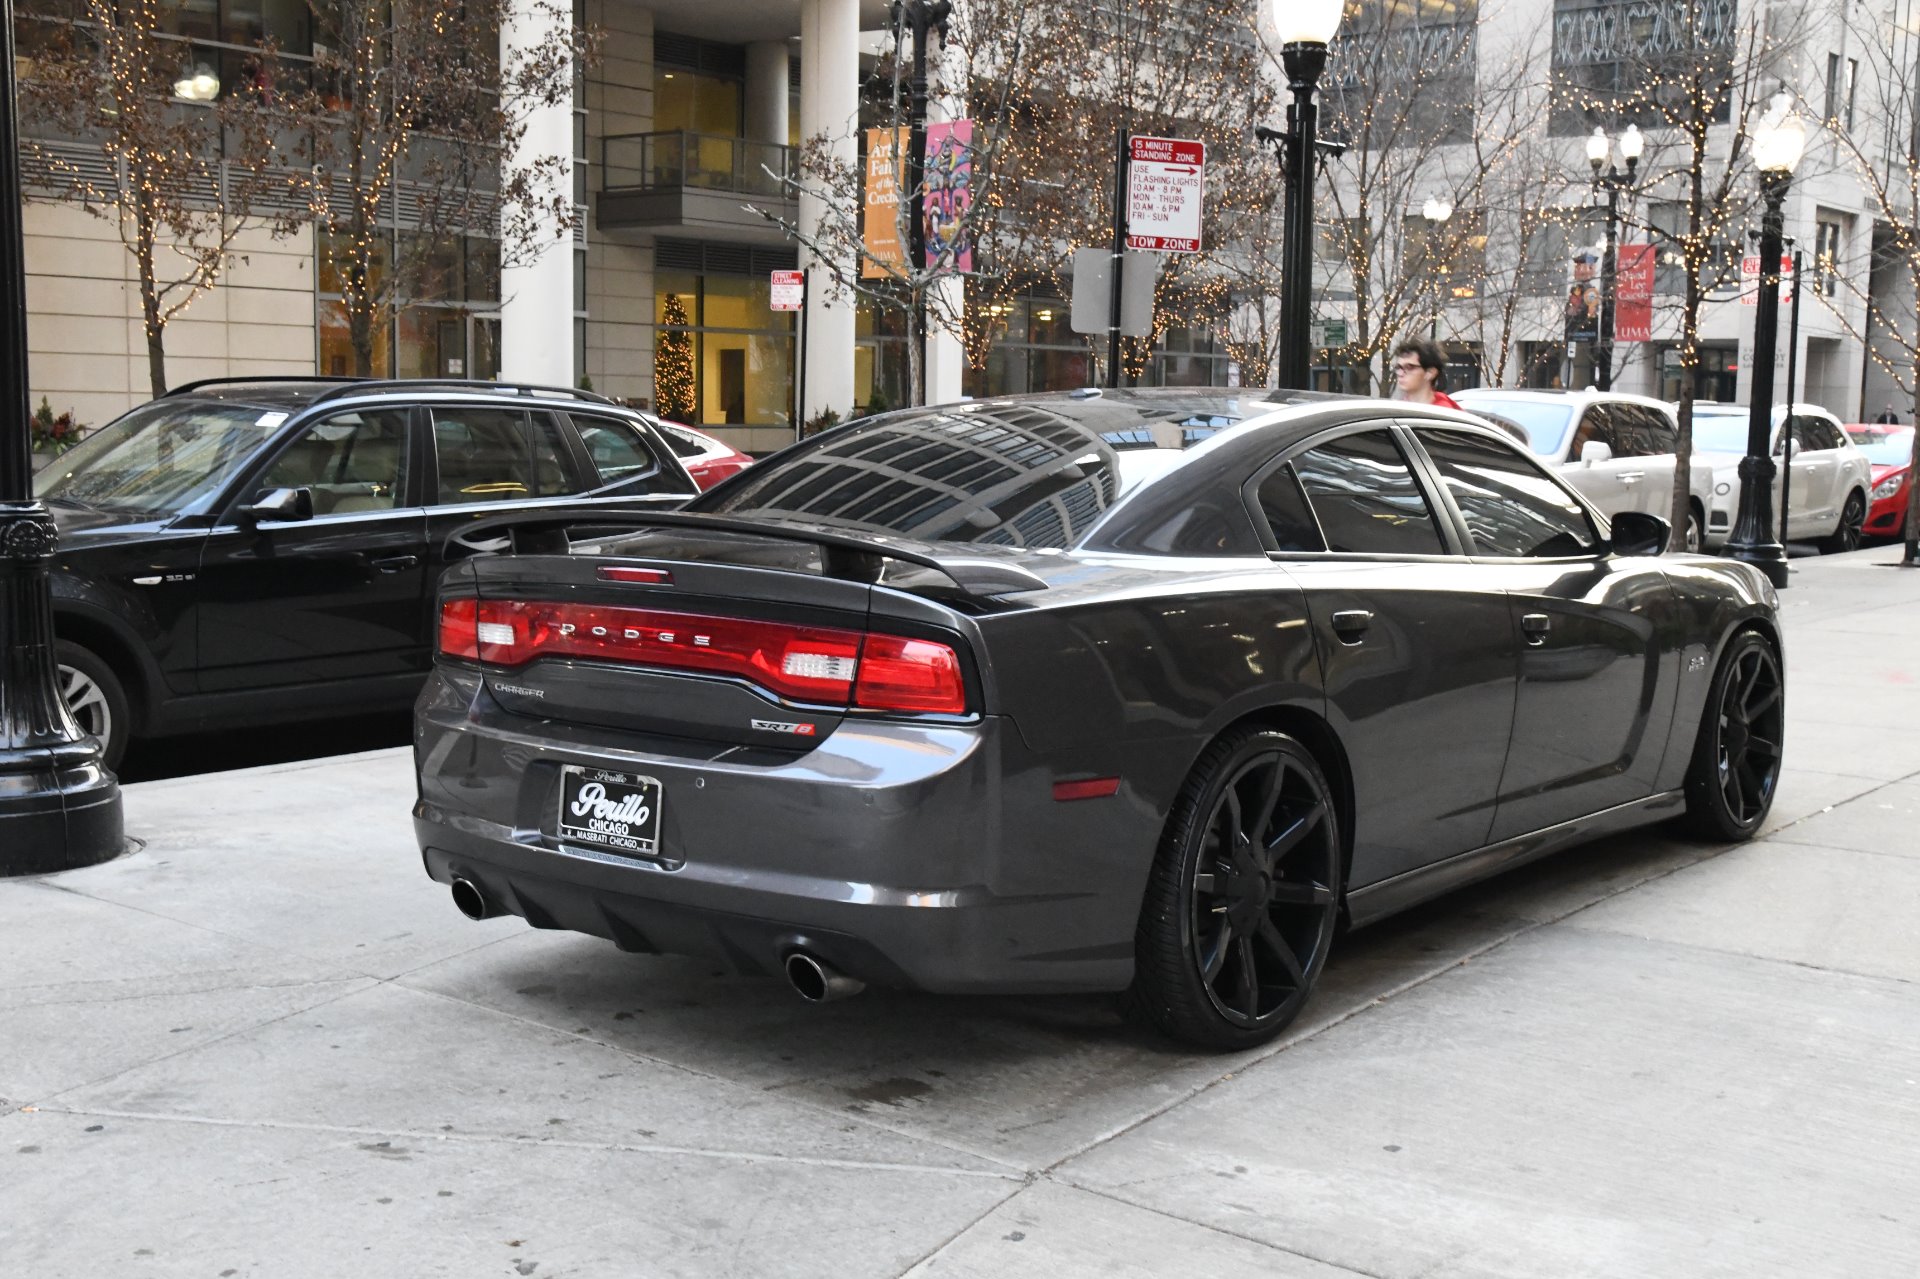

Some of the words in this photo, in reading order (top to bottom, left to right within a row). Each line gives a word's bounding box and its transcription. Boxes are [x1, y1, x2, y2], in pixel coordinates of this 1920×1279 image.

[1135, 141, 1143, 149] 15
[1145, 142, 1173, 152] MINUTE
[1134, 151, 1172, 161] STANDING
[1175, 153, 1196, 163] ZONE
[1134, 165, 1150, 173] USE
[1133, 175, 1171, 185] FLASHING
[1172, 178, 1199, 187] LIGHTS
[1142, 185, 1155, 193] AM
[1163, 186, 1168, 194] 8
[1170, 187, 1182, 195] PM
[1132, 193, 1150, 201] MON
[1159, 194, 1185, 205] THURS
[1141, 204, 1154, 212] AM
[1168, 205, 1180, 213] PM
[1132, 212, 1145, 220] FRI
[1152, 213, 1169, 222] SUN
[1131, 236, 1157, 249] TOW
[1162, 239, 1194, 251] ZONE
[560, 623, 710, 646] DODGE
[494, 683, 544, 699] CHARGER
[595, 769, 627, 784] Perillo
[571, 783, 650, 826] Perillo
[589, 819, 629, 835] CHICAGO
[576, 830, 608, 844] MASERATI
[609, 837, 638, 850] CHICAGO
